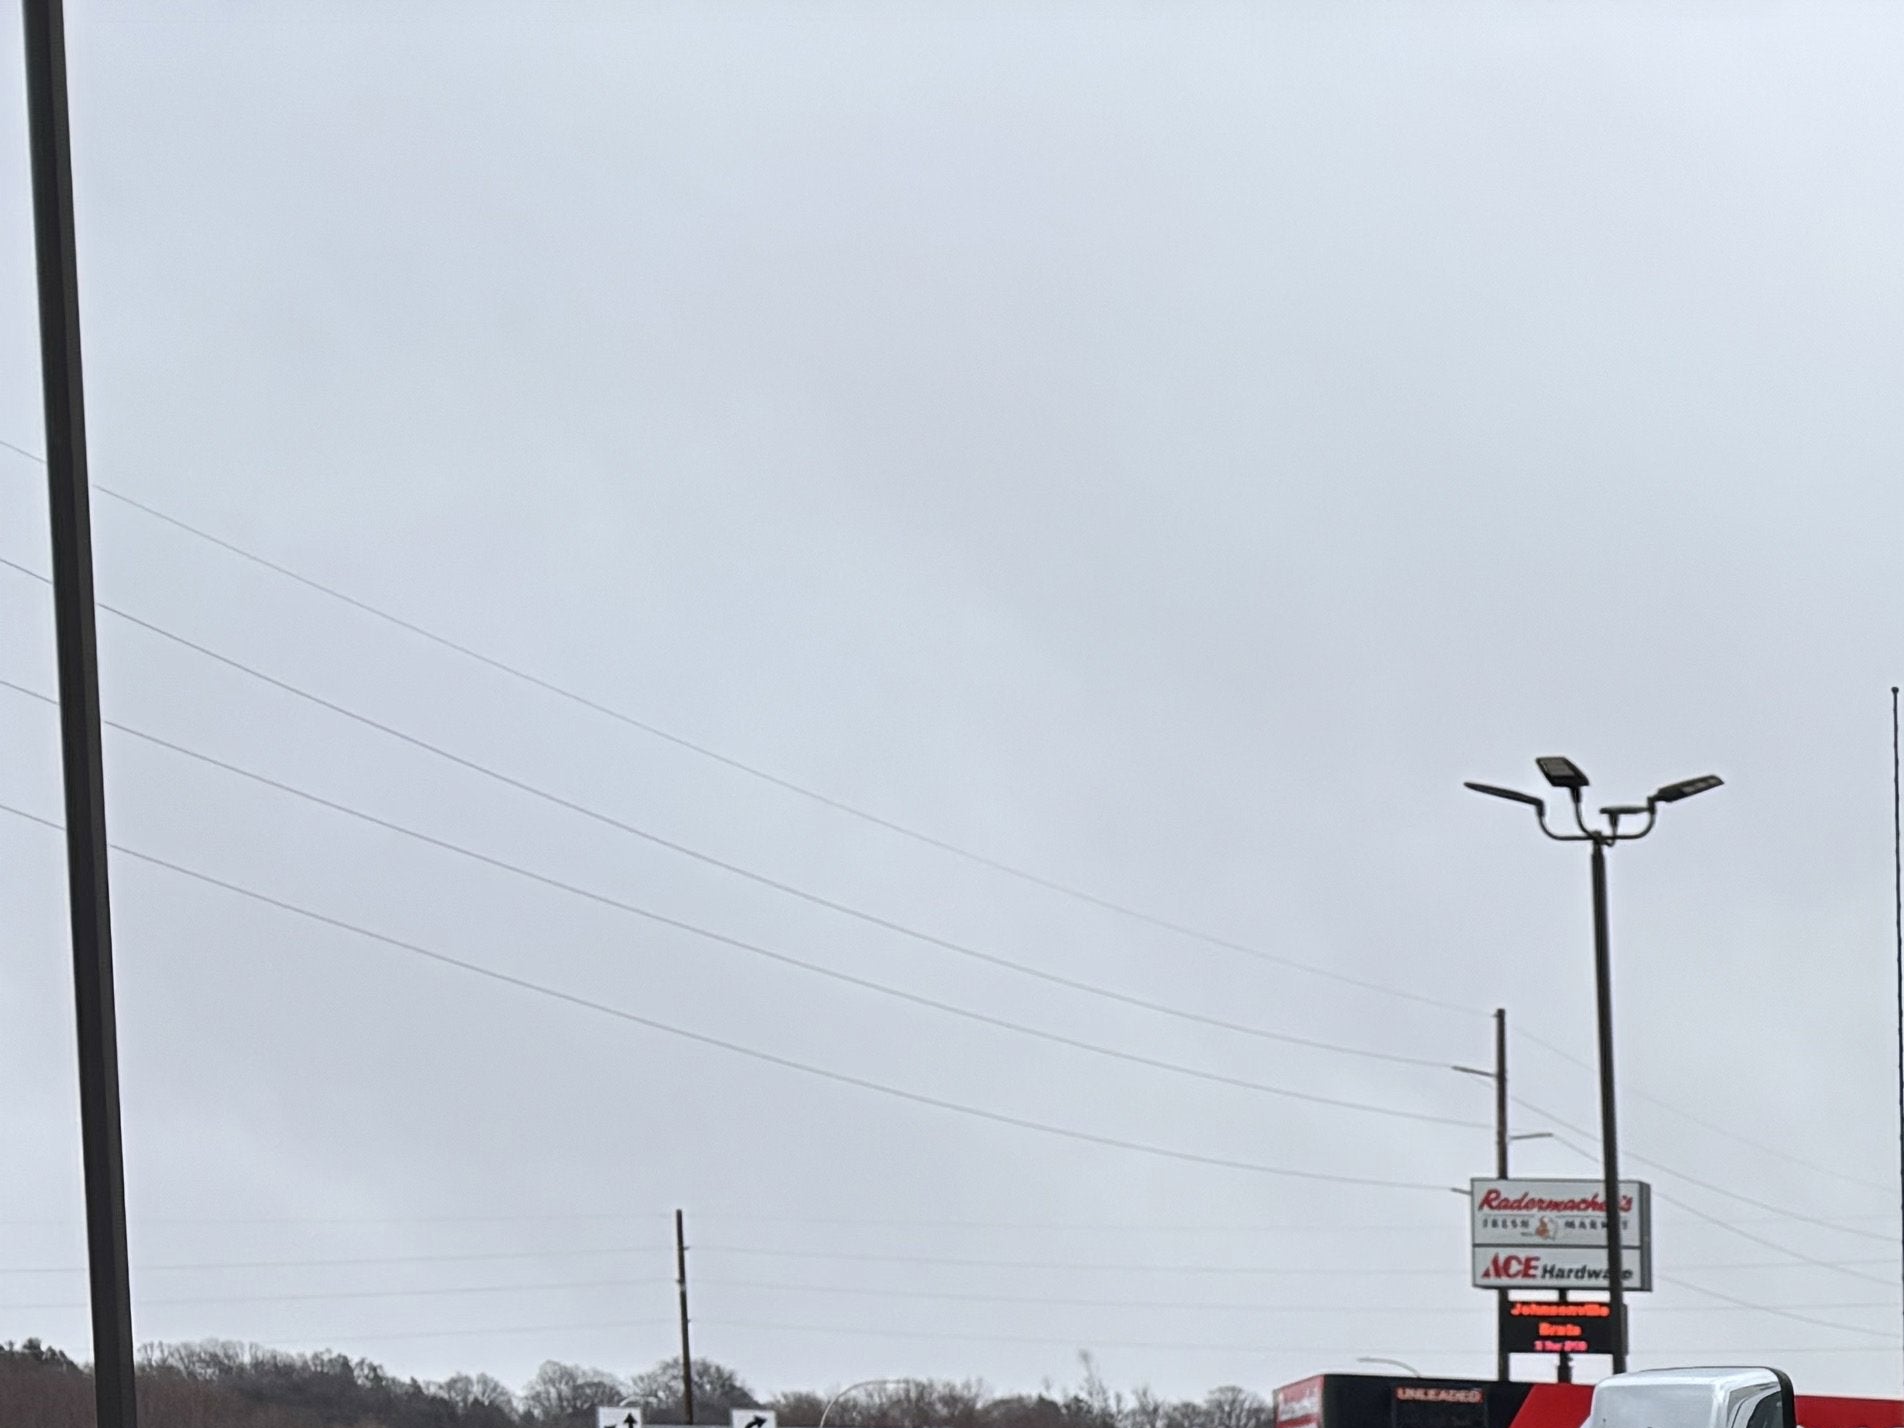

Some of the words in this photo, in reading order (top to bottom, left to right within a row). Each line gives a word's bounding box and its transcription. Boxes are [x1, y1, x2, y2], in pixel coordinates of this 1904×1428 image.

[1478, 1189, 1633, 1213] Radermache's
[1481, 1253, 1541, 1279] ACE
[1541, 1264, 1633, 1280] Hardwae
[1395, 1386, 1484, 1403] UNLEADED
